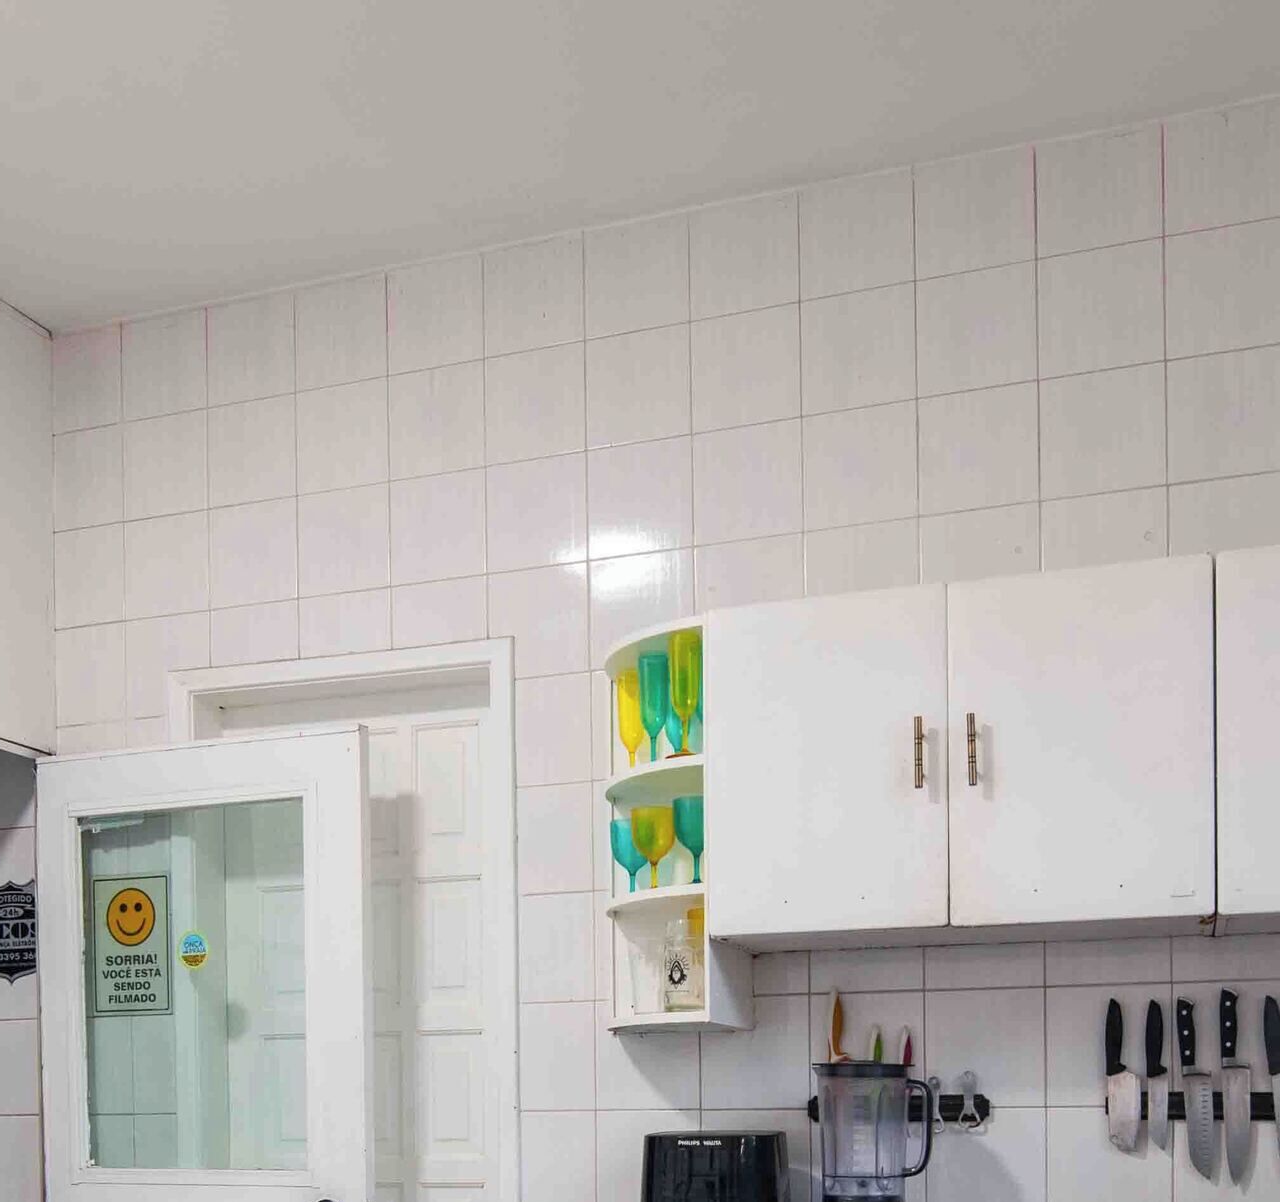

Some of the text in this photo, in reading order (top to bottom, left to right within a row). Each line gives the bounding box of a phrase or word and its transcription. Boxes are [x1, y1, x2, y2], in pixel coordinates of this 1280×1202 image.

[2, 908, 19, 916] 24h
[22, 951, 36, 961] 36
[105, 953, 158, 967] SORRIA!
[113, 981, 151, 991] SENDO
[108, 993, 157, 1004] FILMADO
